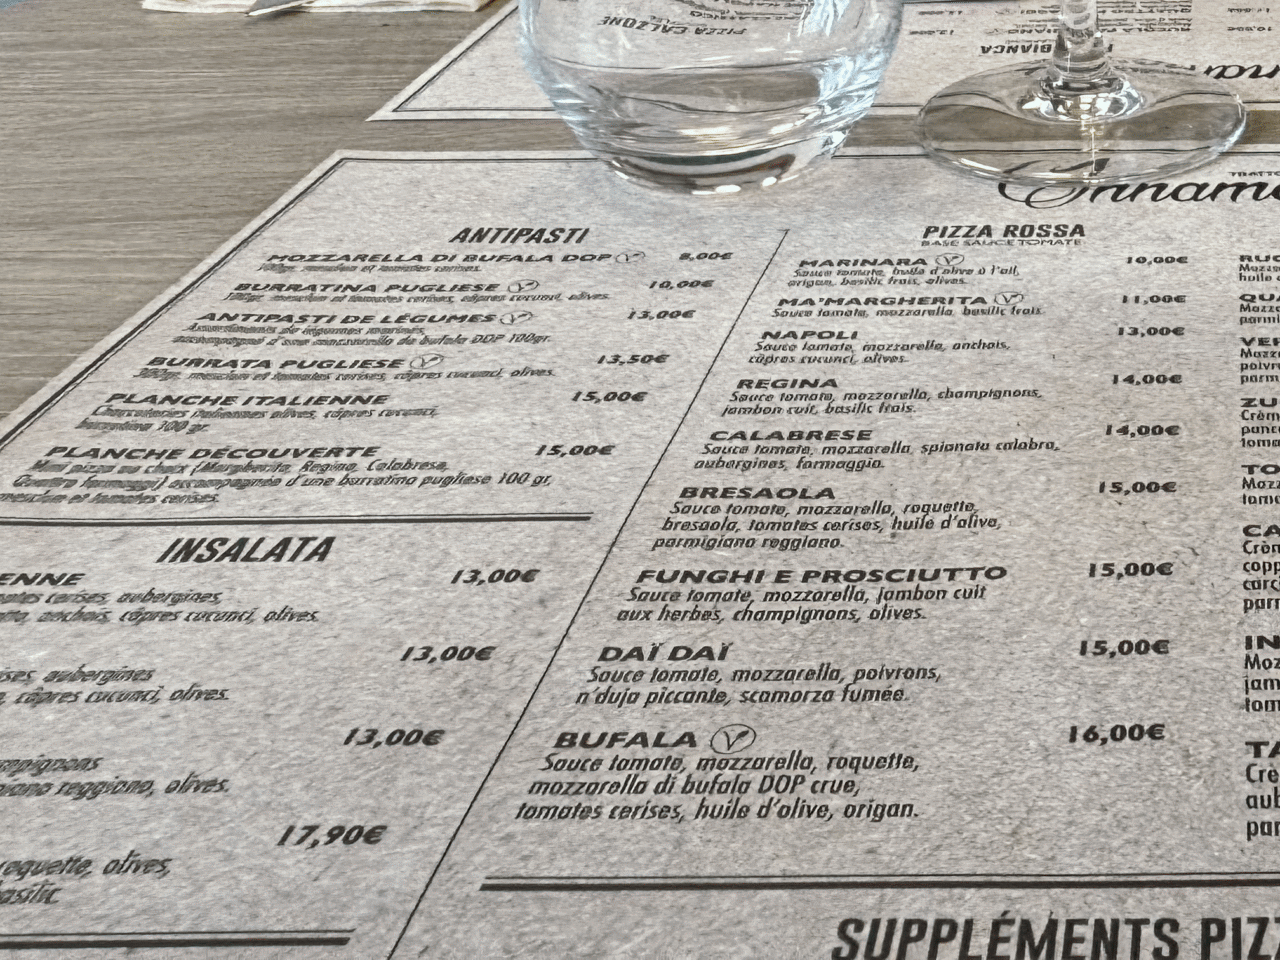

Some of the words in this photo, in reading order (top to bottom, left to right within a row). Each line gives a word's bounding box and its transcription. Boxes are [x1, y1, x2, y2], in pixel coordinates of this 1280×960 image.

[449, 228, 590, 243] ANTIPASTI
[922, 224, 992, 238] PIZZA
[1003, 224, 1086, 238] ROSSA
[267, 254, 422, 262] MOZZARELLA
[430, 254, 457, 262] DI
[462, 254, 553, 262] BUFALA
[561, 254, 612, 262] DOP
[679, 252, 734, 261] 8,00€
[799, 258, 928, 267] MARINARA
[1126, 256, 1188, 266] 10,00€
[234, 284, 376, 292] BURRATINA
[384, 284, 500, 292] PUGLIESE
[649, 280, 714, 290] 10,00€
[777, 296, 988, 306] MA'MARGHERITA
[1122, 295, 1186, 305] 11,00€
[197, 313, 337, 323] ANTIPASTI
[340, 315, 375, 323] DE
[380, 312, 496, 323] LÉGUMES
[628, 310, 696, 320] 13,00€
[761, 331, 859, 340] NAPOLI
[1118, 327, 1185, 338] 13,00€
[146, 356, 270, 368] BURRATA
[279, 358, 404, 368] PUGLIESE
[598, 354, 670, 366] 13,50€
[736, 379, 838, 389] REGINA
[1112, 374, 1182, 386] 14,00€
[106, 393, 238, 405] PLANCHE
[242, 394, 390, 406] ITALIENNE
[571, 391, 648, 403] 15,00€
[710, 430, 872, 441] CALABRESE
[1105, 425, 1180, 438] 14,00€
[44, 446, 184, 460] PLANCHE
[188, 445, 380, 459] DÉCOUVERTE
[535, 444, 615, 458] 15,00€
[679, 487, 836, 499] BRESAOLA
[1099, 481, 1177, 496] 15,00€
[155, 536, 336, 563] INSALATA
[451, 568, 540, 586] 13,00€
[636, 569, 765, 584] FUNGHI
[773, 571, 793, 583] E
[801, 566, 1008, 584] PROSCIUTTO
[1089, 562, 1173, 580] 15,00€
[399, 645, 497, 664] 13,00€
[598, 642, 663, 662] DAÏ
[668, 641, 734, 662] DAÏ
[1080, 639, 1170, 658] 15,00€
[587, 665, 644, 683] Sauce
[651, 665, 722, 685] tomate,
[733, 662, 845, 685] mozzarella,
[644, 687, 730, 708] piccante,
[739, 689, 834, 703] scamorza
[343, 728, 445, 748] 13,00€
[553, 731, 698, 749] BUFALA
[1069, 723, 1166, 746] 16,00€
[538, 752, 603, 772] Sauce
[609, 752, 688, 774] tomate,
[697, 749, 819, 774] mozzarella,
[827, 751, 920, 774] roquette,
[528, 774, 648, 796] mozzarella
[655, 774, 678, 795] di
[681, 774, 751, 795] bufala
[758, 774, 808, 795] DOP
[811, 777, 860, 797] crue,
[515, 801, 603, 821] tomates
[609, 800, 685, 823] cerises,
[695, 797, 750, 820] huile
[756, 797, 833, 821] d'olive,
[843, 799, 920, 824] origan.
[276, 824, 389, 849] 17,90€
[831, 910, 1180, 960] SUPPLÉMENTS
